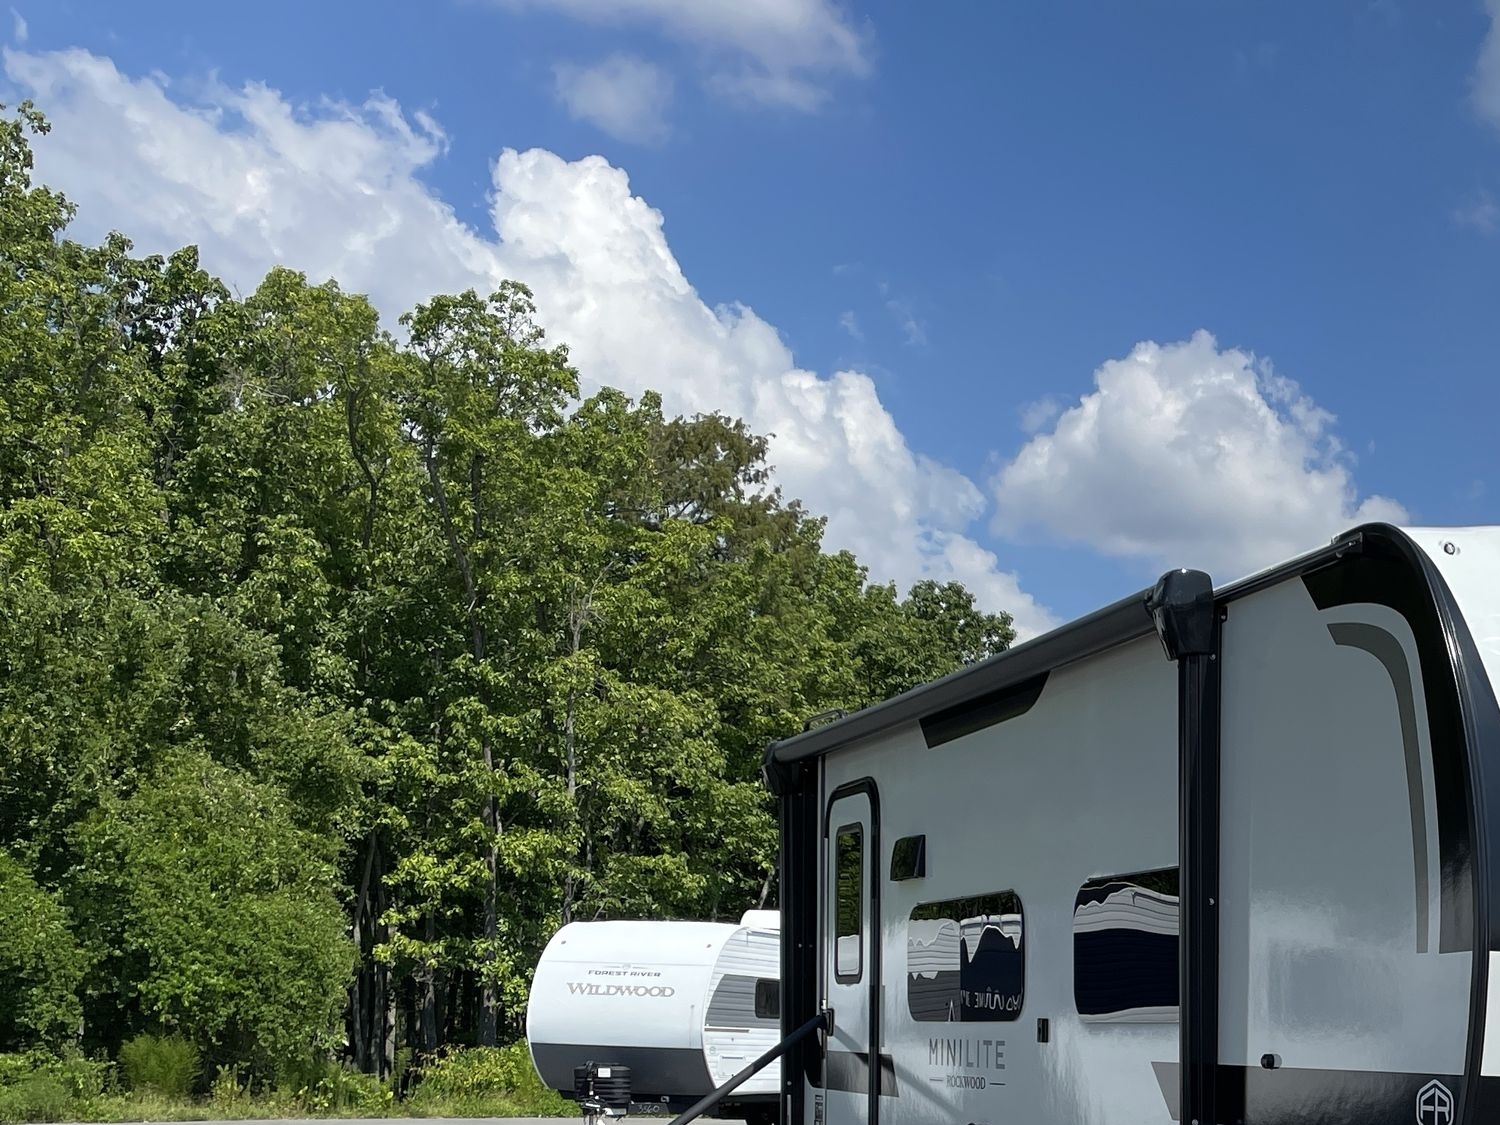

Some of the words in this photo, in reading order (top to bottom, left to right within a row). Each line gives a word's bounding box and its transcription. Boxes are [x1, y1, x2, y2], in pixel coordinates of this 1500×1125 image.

[566, 981, 676, 998] WILDWOOD
[928, 1037, 1006, 1070] MINILITE
[946, 1074, 986, 1090] ROCKWOOD
